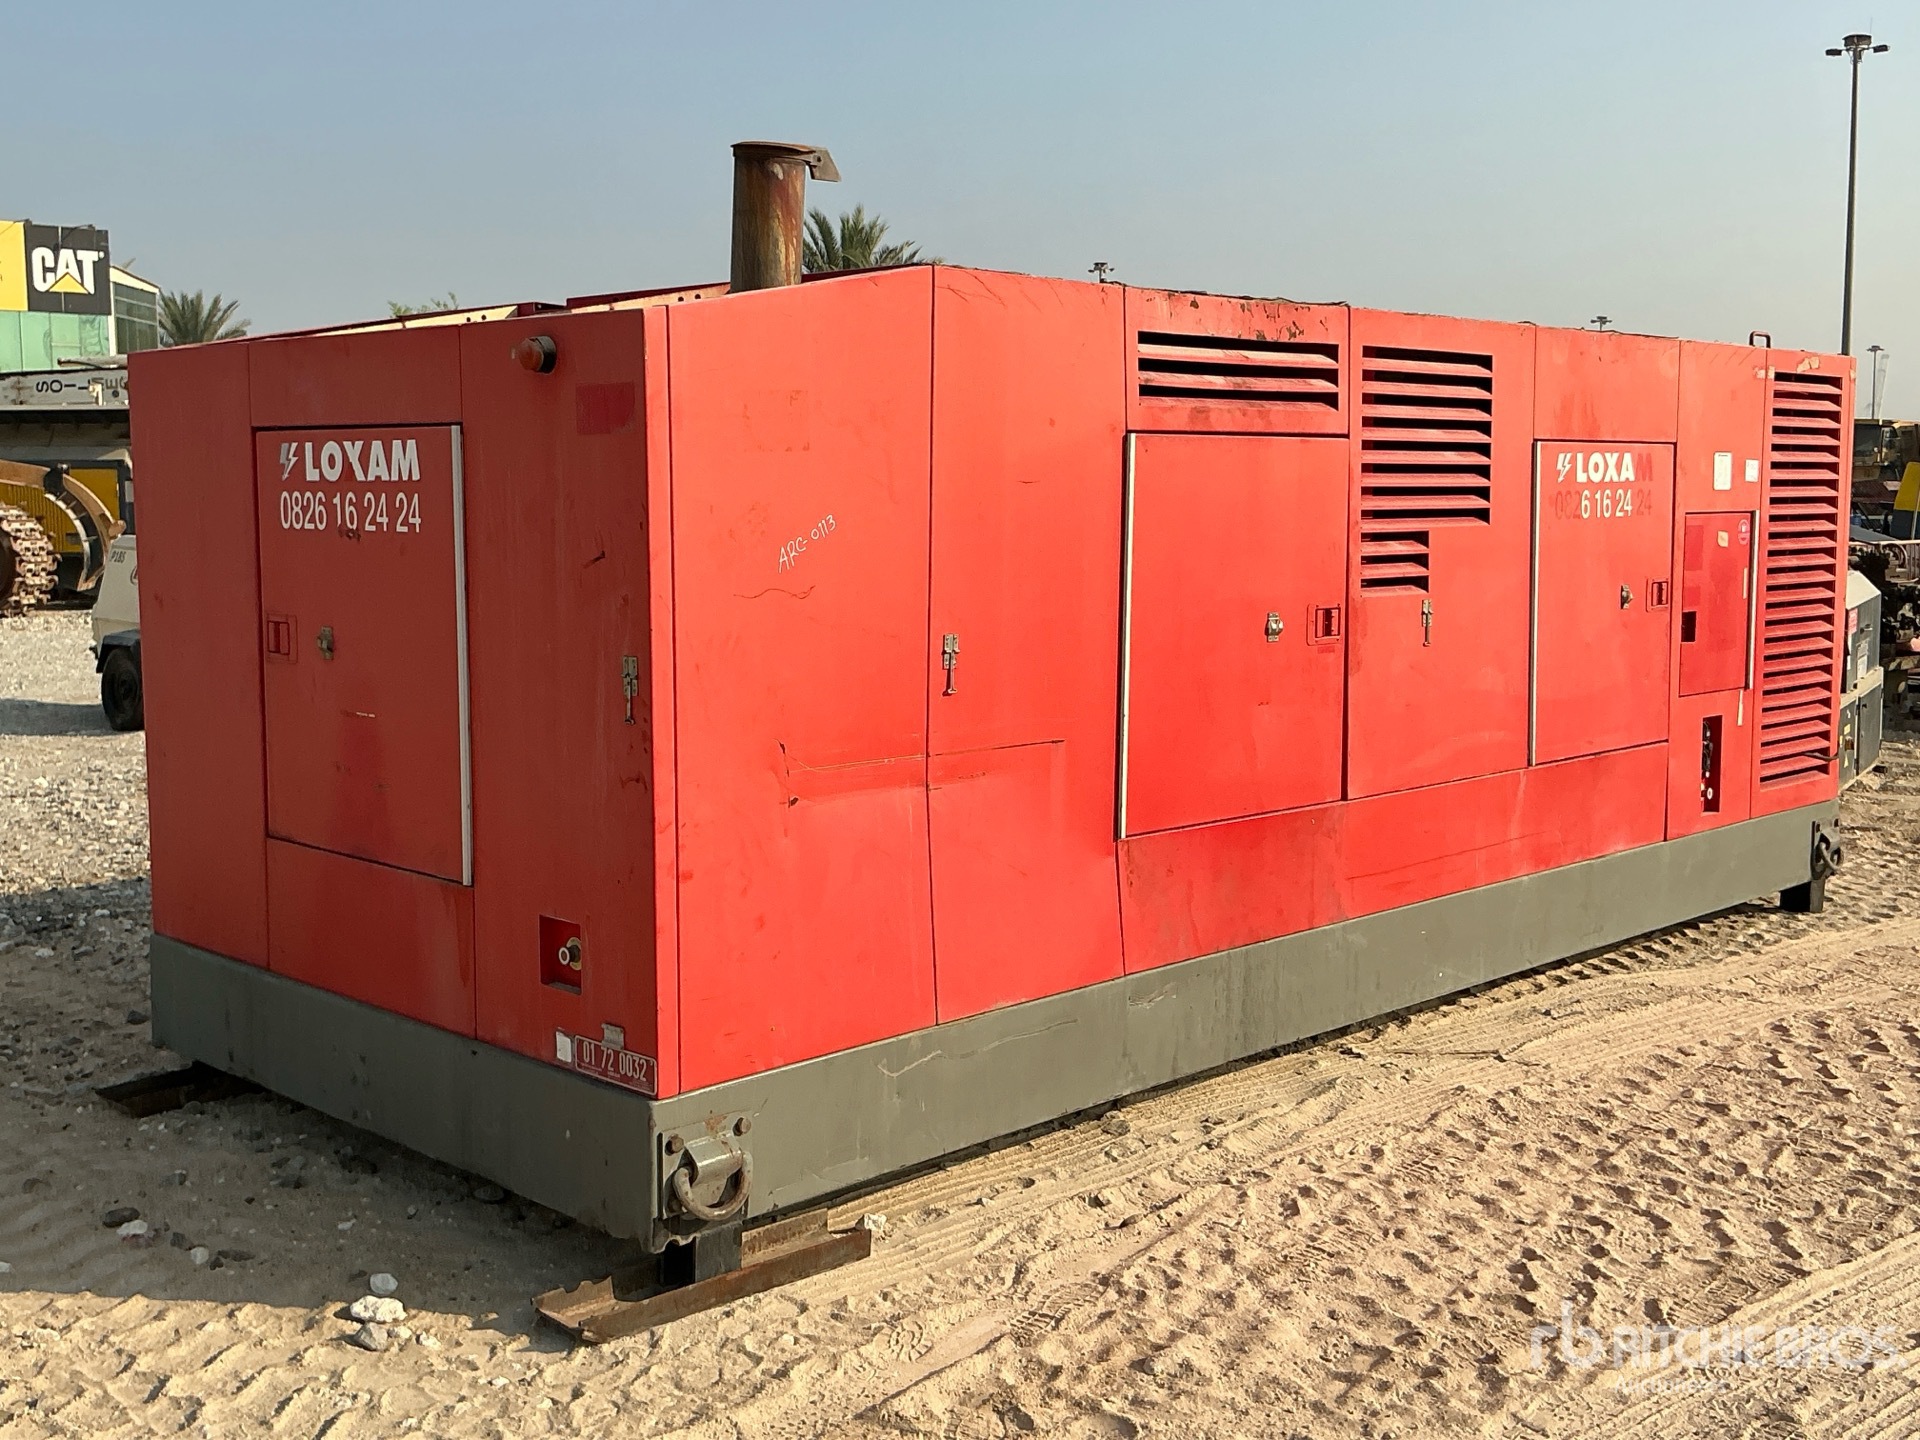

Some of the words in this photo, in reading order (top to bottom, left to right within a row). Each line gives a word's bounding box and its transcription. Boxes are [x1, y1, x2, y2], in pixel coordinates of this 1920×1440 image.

[31, 247, 100, 295] CAT
[304, 439, 421, 482] LOXAM
[280, 490, 327, 530] 0826
[332, 491, 358, 530] 16
[363, 491, 389, 532] 24
[395, 492, 422, 533] 24
[1594, 489, 1612, 518] 16
[1615, 488, 1633, 517] 24
[583, 1040, 595, 1066] 01
[601, 1047, 614, 1072] 72
[619, 1052, 647, 1082] 0032
